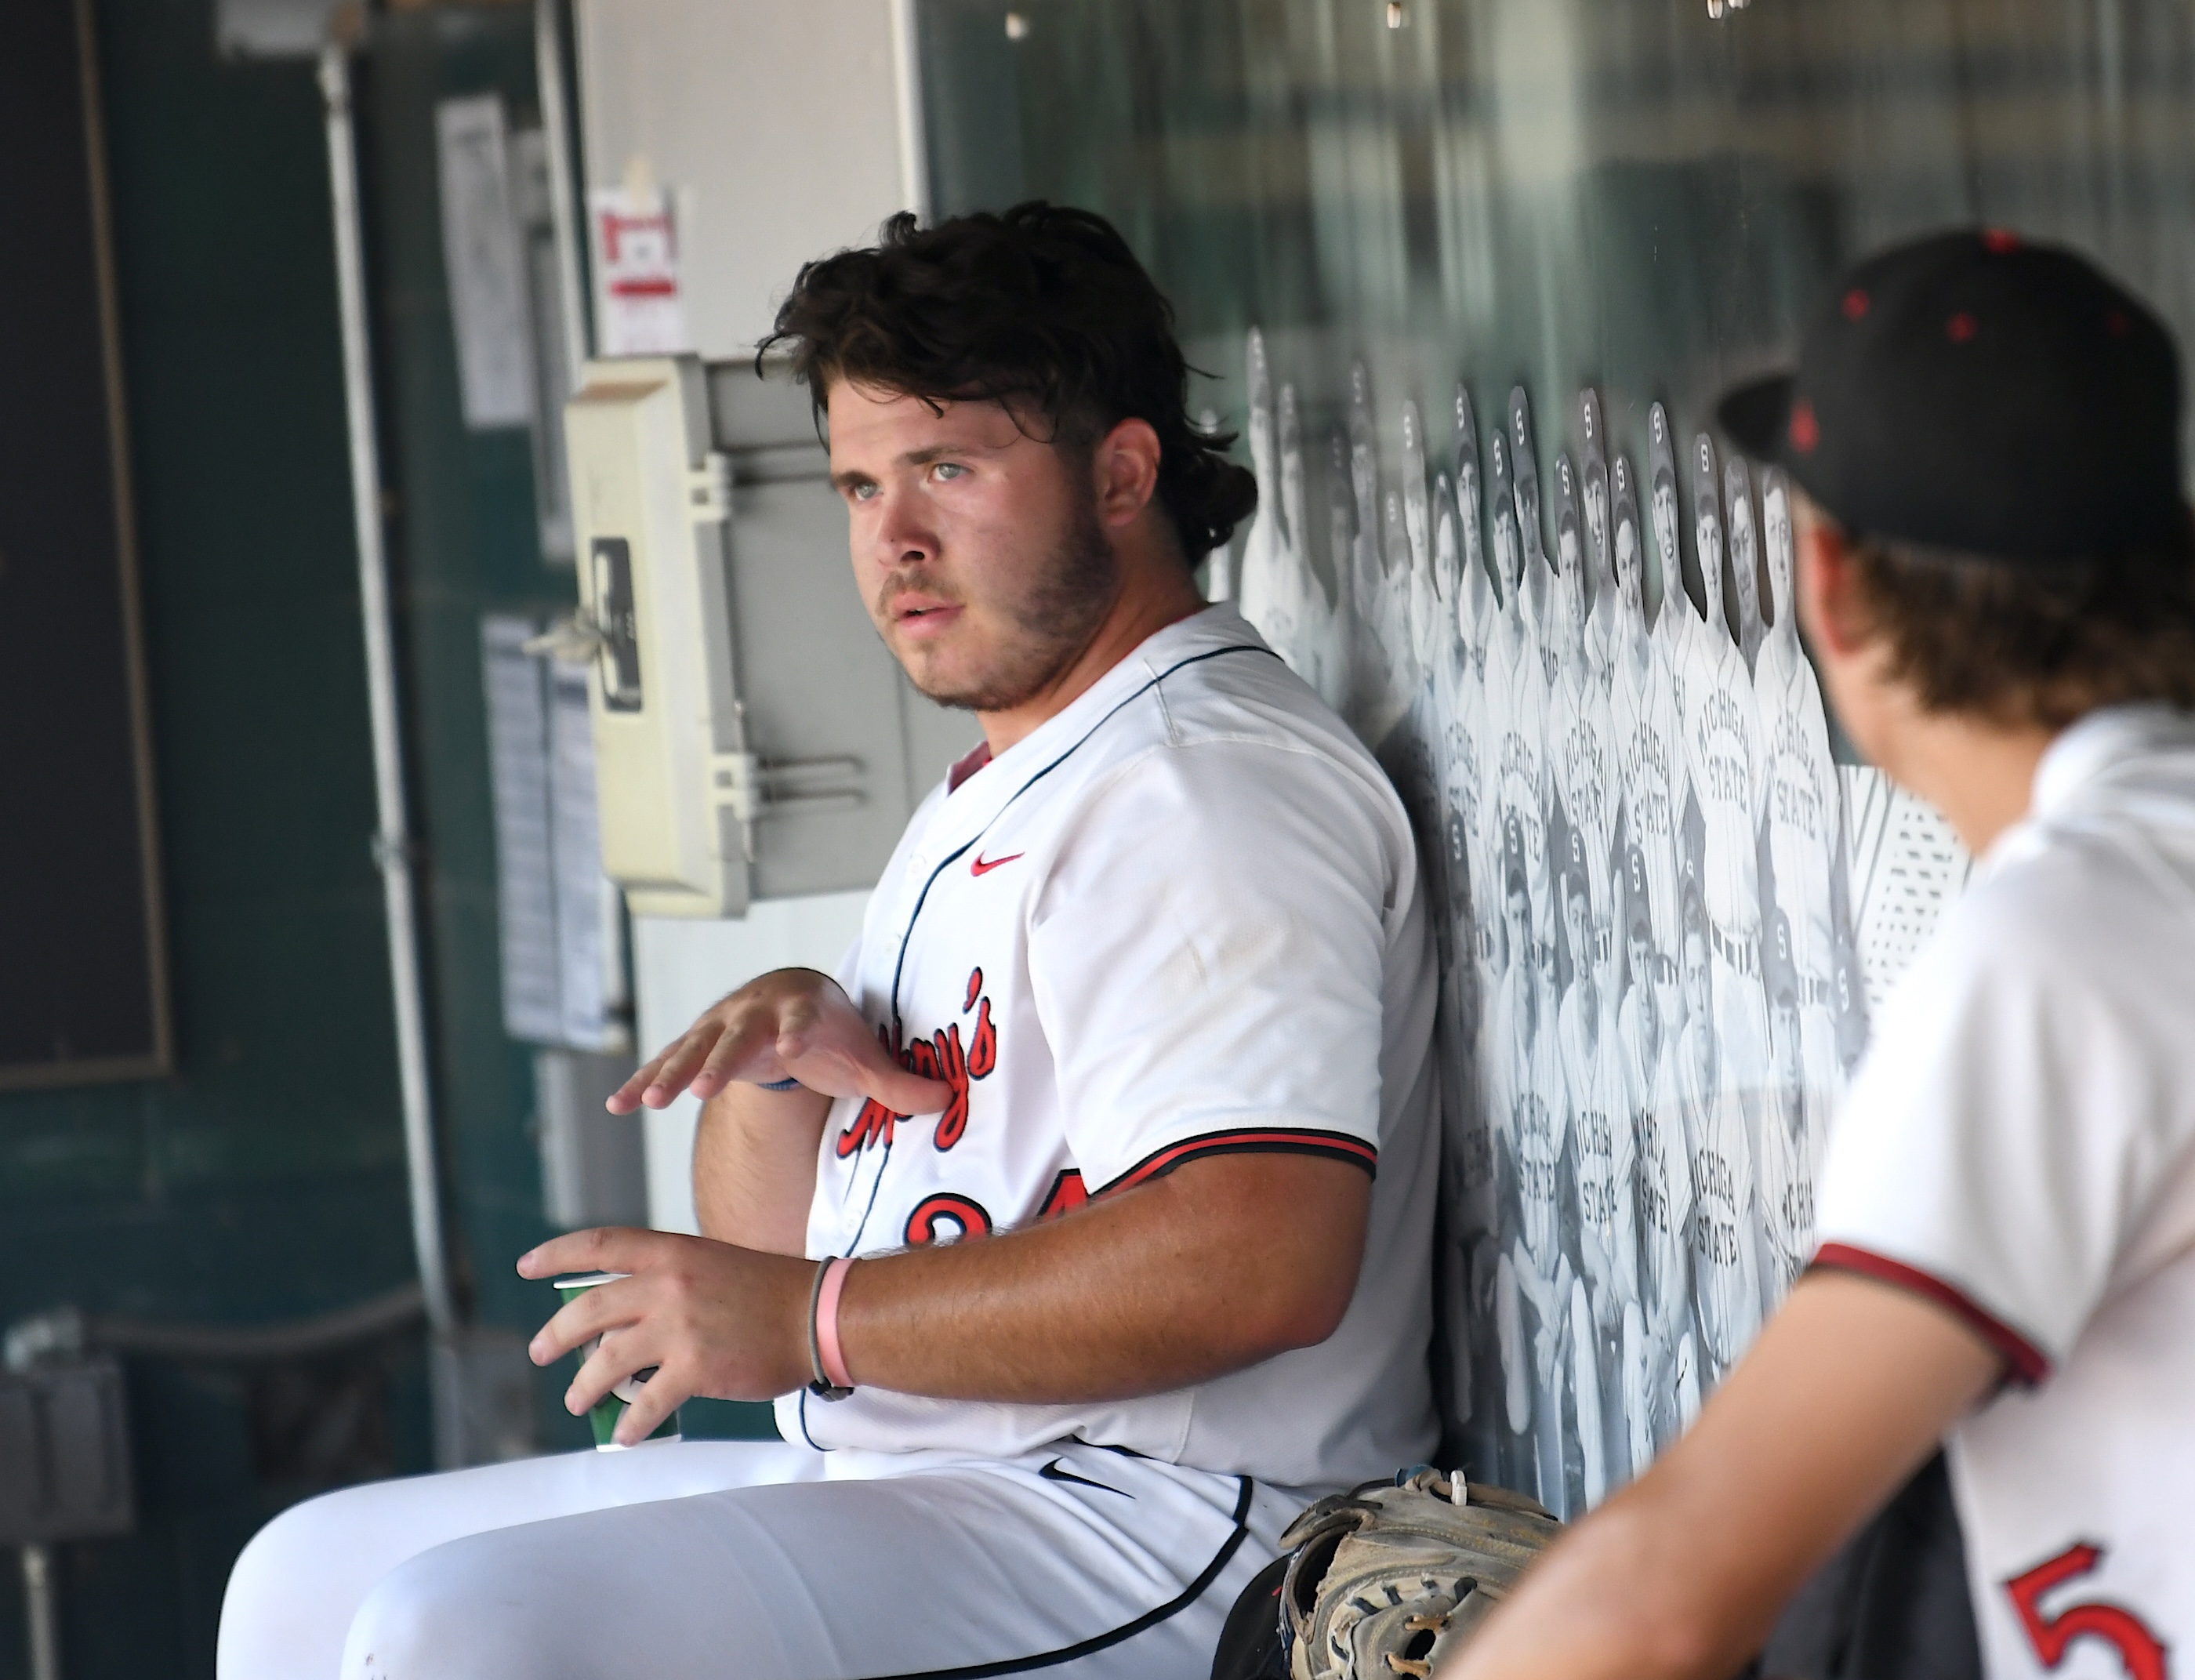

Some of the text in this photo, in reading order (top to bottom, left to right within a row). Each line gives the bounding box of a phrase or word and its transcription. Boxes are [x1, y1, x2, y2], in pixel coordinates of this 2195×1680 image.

[1515, 408, 1526, 447] S
[1584, 402, 1594, 441] S
[1653, 409, 1663, 445] S
[1493, 437, 1503, 477] S
[1616, 456, 1626, 493] S
[1561, 463, 1571, 496] S
[1707, 754, 1748, 815] STATE
[1776, 776, 1816, 841] STATE
[1508, 818, 1519, 855] S
[1572, 831, 1581, 863] S
[1631, 852, 1642, 894] S
[1776, 923, 1787, 961] S
[1582, 1173, 1619, 1225] STATE
[1696, 1215, 1738, 1268] STATE
[1999, 1539, 2170, 1680] 5
